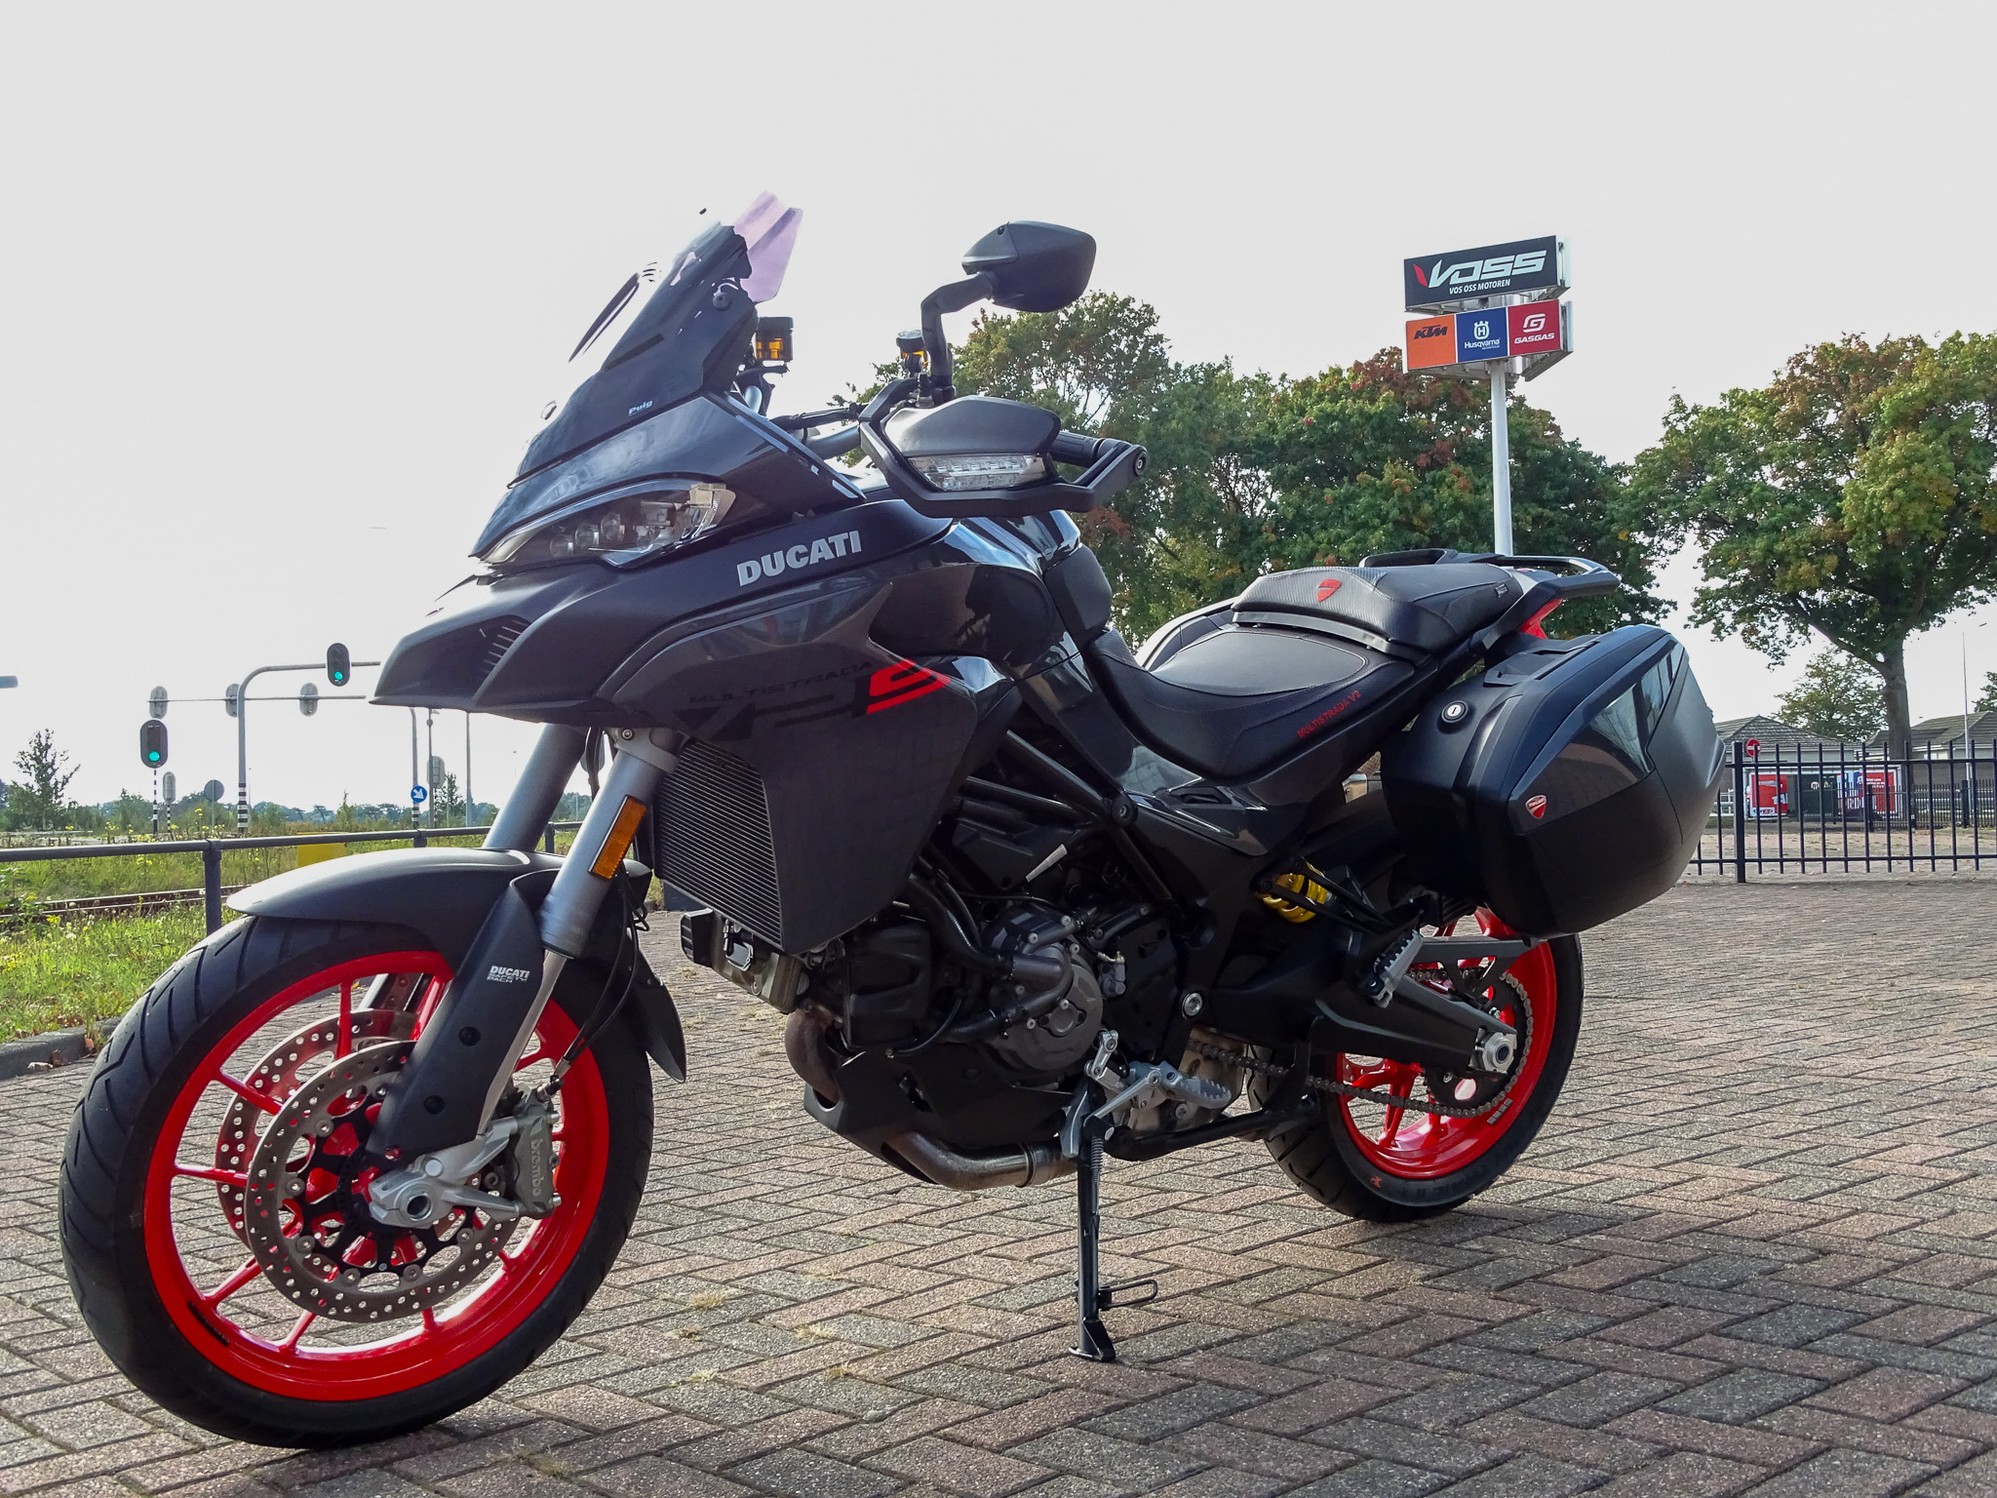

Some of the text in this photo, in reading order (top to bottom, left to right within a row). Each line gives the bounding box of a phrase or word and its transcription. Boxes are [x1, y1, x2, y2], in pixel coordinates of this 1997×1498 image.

[1413, 250, 1547, 288] VOSS
[1449, 279, 1511, 294] VOS OSS MOTOREN
[1414, 325, 1448, 340] KTM
[1514, 333, 1555, 344] GASGAS
[1464, 339, 1500, 349] Husqvarna
[736, 530, 862, 587] DUCATI
[490, 965, 530, 978] DUCATI
[530, 1138, 545, 1197] brembo
